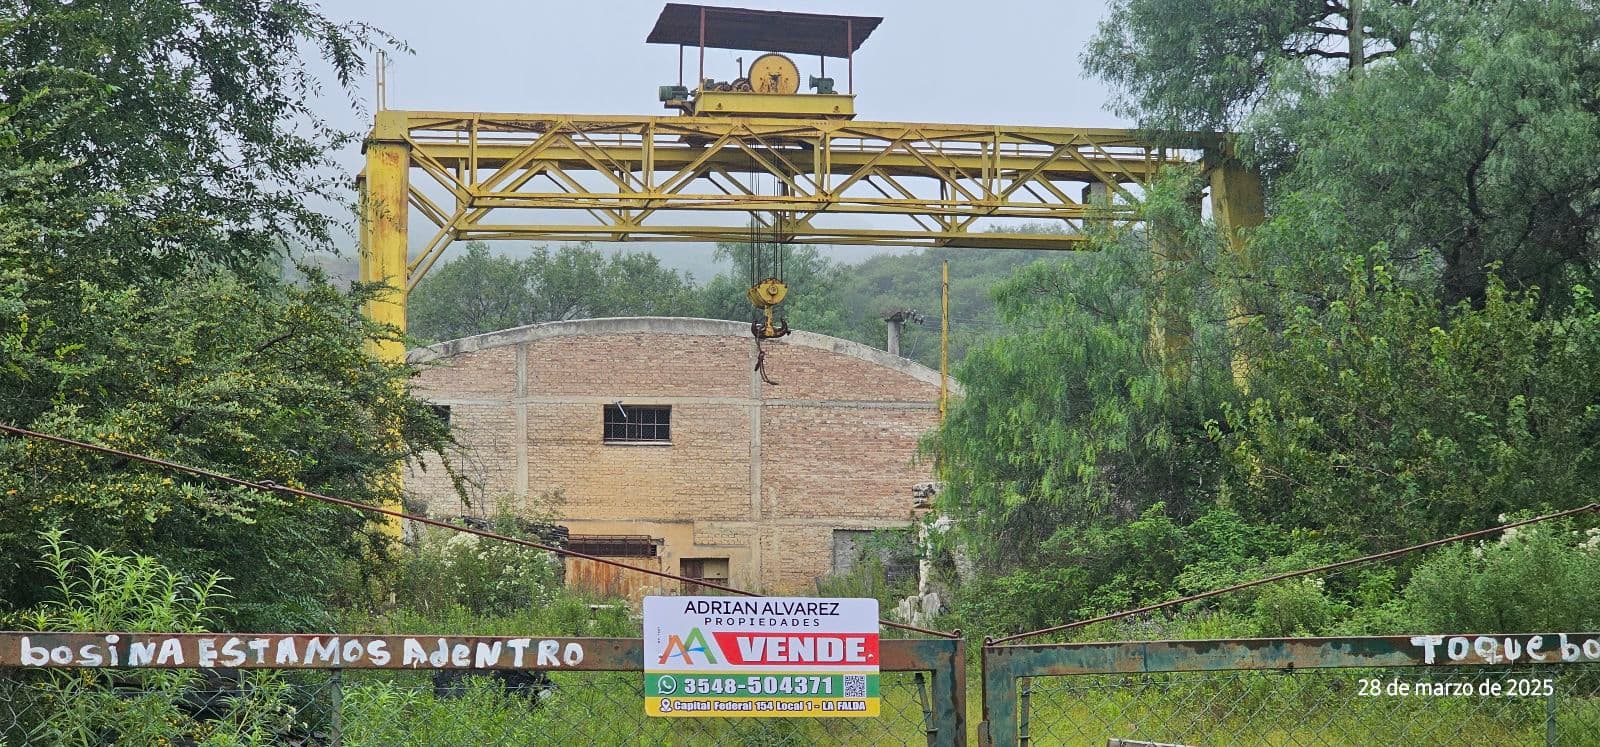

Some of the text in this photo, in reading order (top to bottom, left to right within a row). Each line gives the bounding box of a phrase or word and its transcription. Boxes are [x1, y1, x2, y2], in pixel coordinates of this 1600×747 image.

[684, 600, 839, 616] ADRIAN ALVAREZ
[704, 617, 820, 627] PROPIEDADES
[199, 636, 391, 667] ESTAMOS
[684, 676, 833, 695] 3548-504371
[673, 700, 711, 711] Capital
[713, 700, 752, 711] Federal
[755, 700, 774, 711] 154
[776, 700, 803, 711] Local
[806, 700, 812, 711] 1
[822, 701, 834, 711] LA
[837, 700, 866, 711] FALDA
